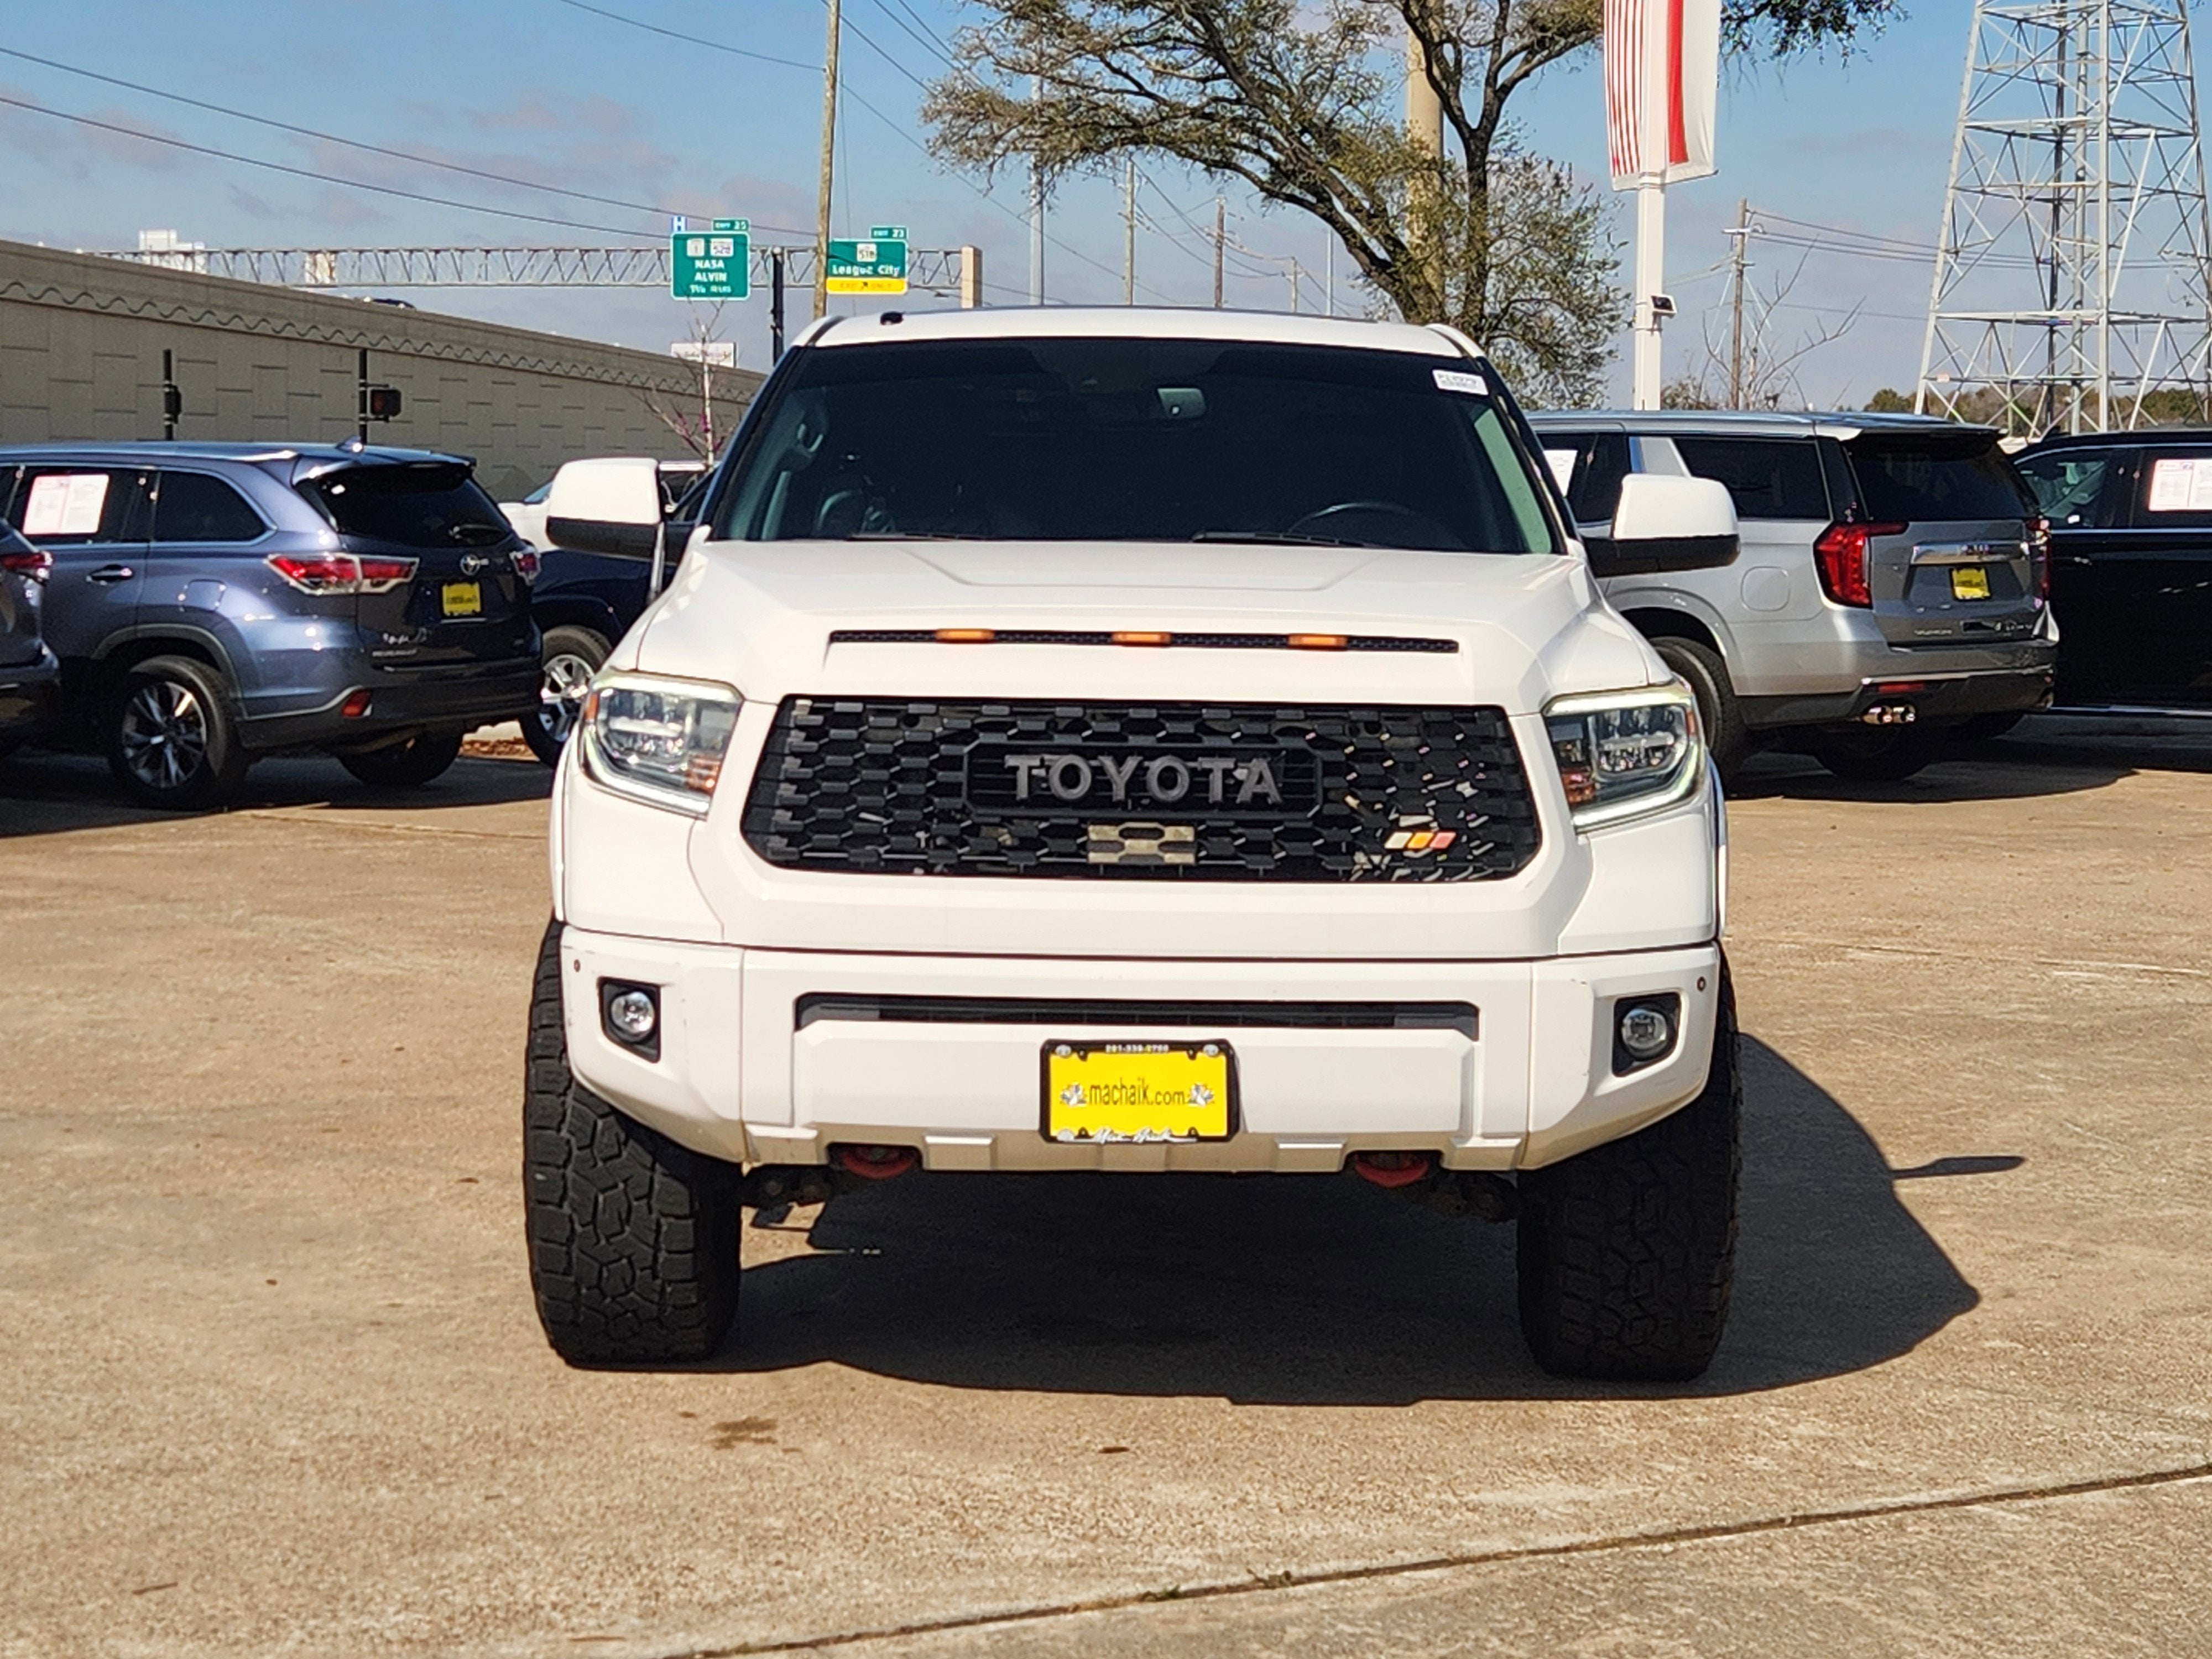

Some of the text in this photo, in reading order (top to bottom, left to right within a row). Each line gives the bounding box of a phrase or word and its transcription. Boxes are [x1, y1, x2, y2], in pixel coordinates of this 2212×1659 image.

[859, 249, 875, 259] 518
[695, 259, 725, 269] NASA
[832, 264, 901, 276] League City
[695, 272, 727, 282] ALVIN
[1004, 754, 1282, 804] TOYOTA
[1089, 1077, 1185, 1105] machaik.com
